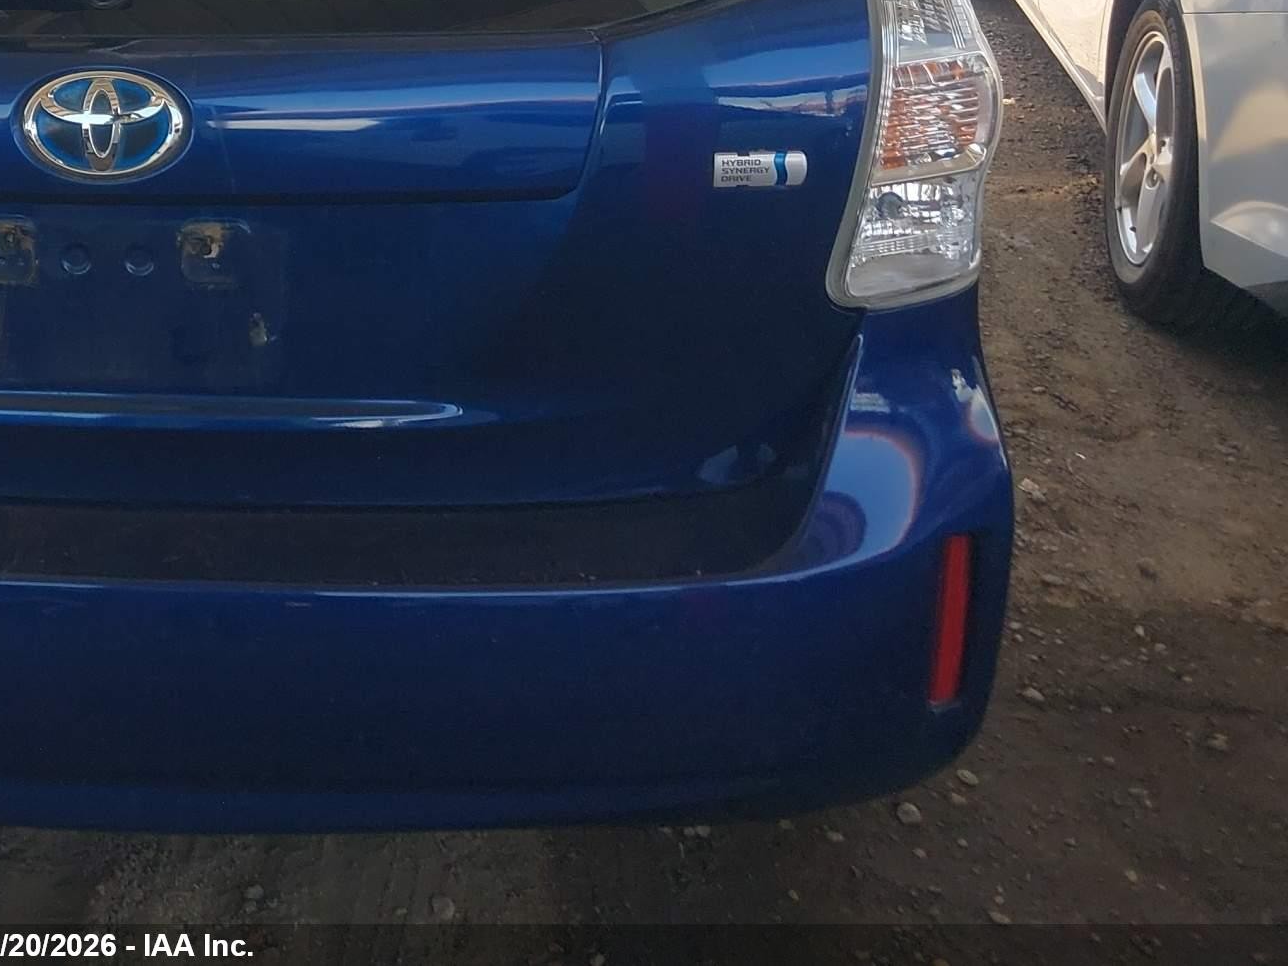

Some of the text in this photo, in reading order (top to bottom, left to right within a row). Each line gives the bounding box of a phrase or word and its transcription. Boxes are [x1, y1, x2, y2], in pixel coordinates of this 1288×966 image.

[721, 159, 762, 167] HYBRID
[721, 167, 770, 175] SYNERGY
[720, 175, 752, 183] DRIVE
